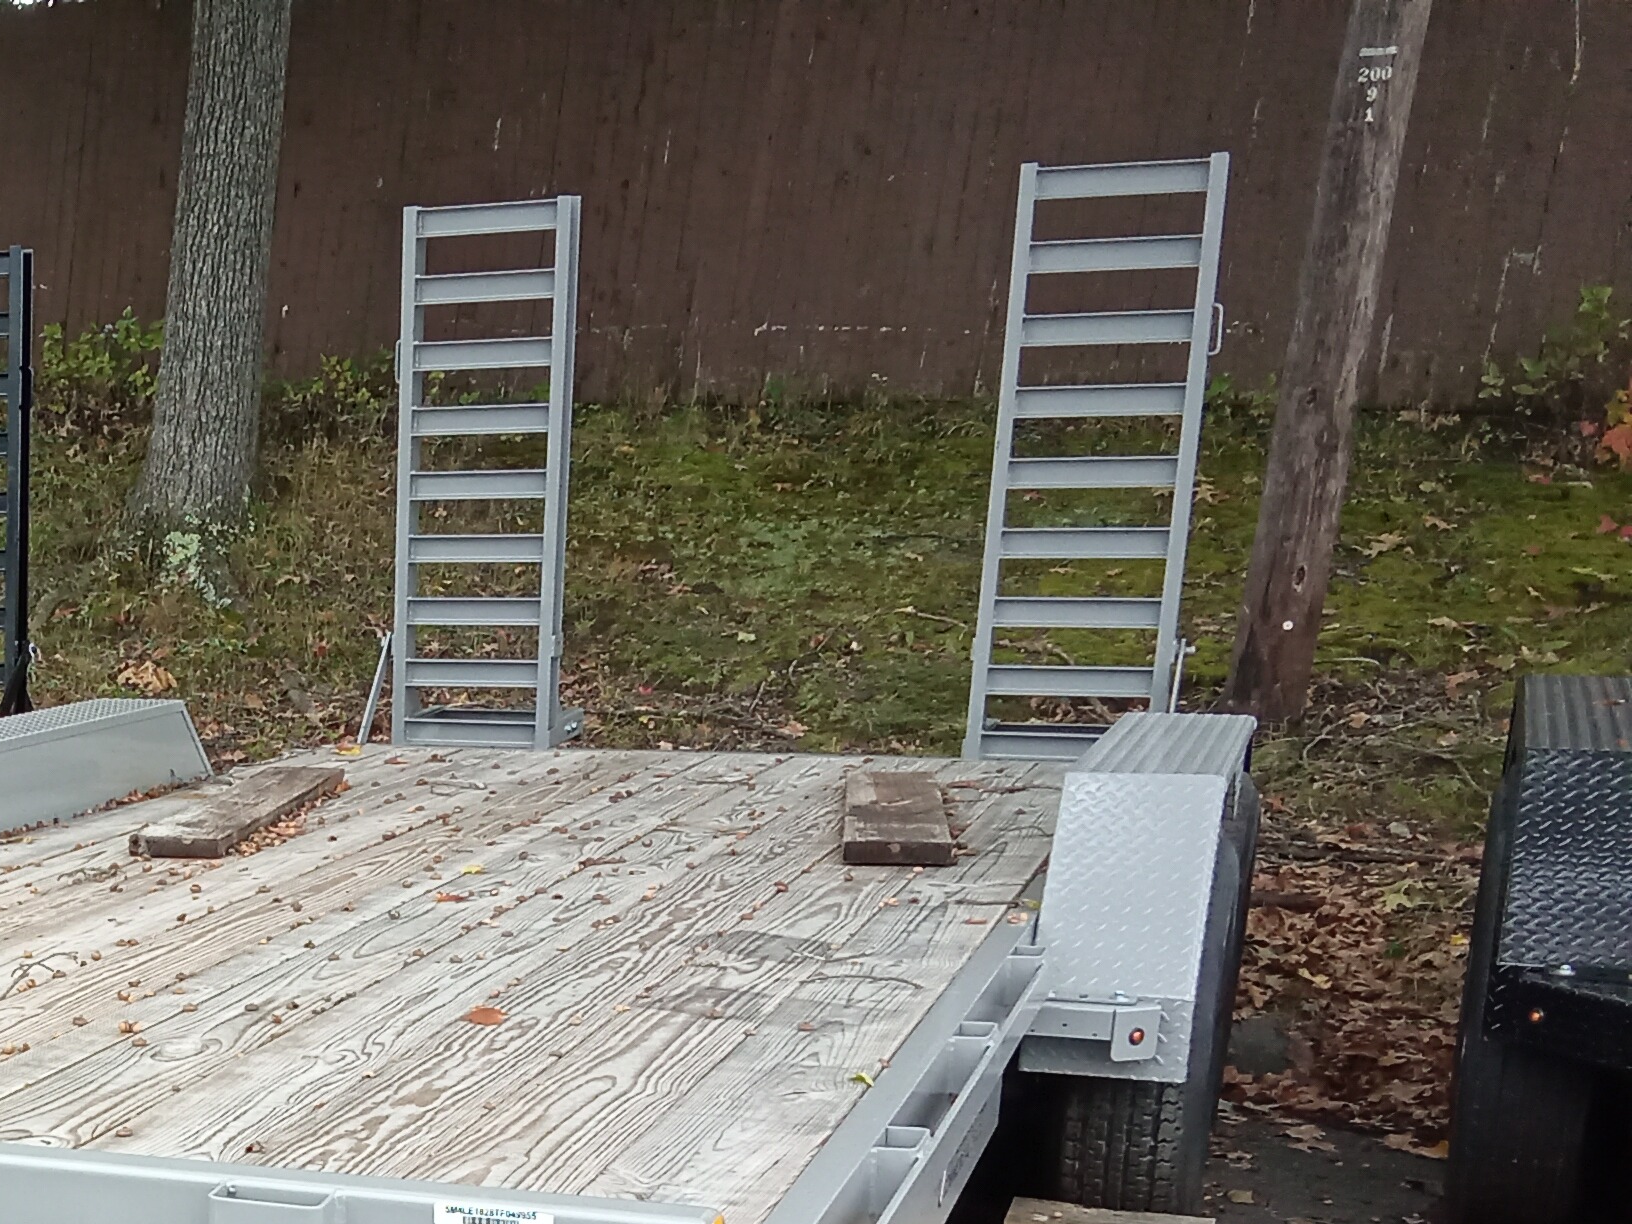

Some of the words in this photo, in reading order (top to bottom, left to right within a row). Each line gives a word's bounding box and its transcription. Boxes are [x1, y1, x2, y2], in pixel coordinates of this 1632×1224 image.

[1357, 66, 1393, 83] 200
[1366, 86, 1378, 102] 9
[1364, 107, 1374, 122] 1
